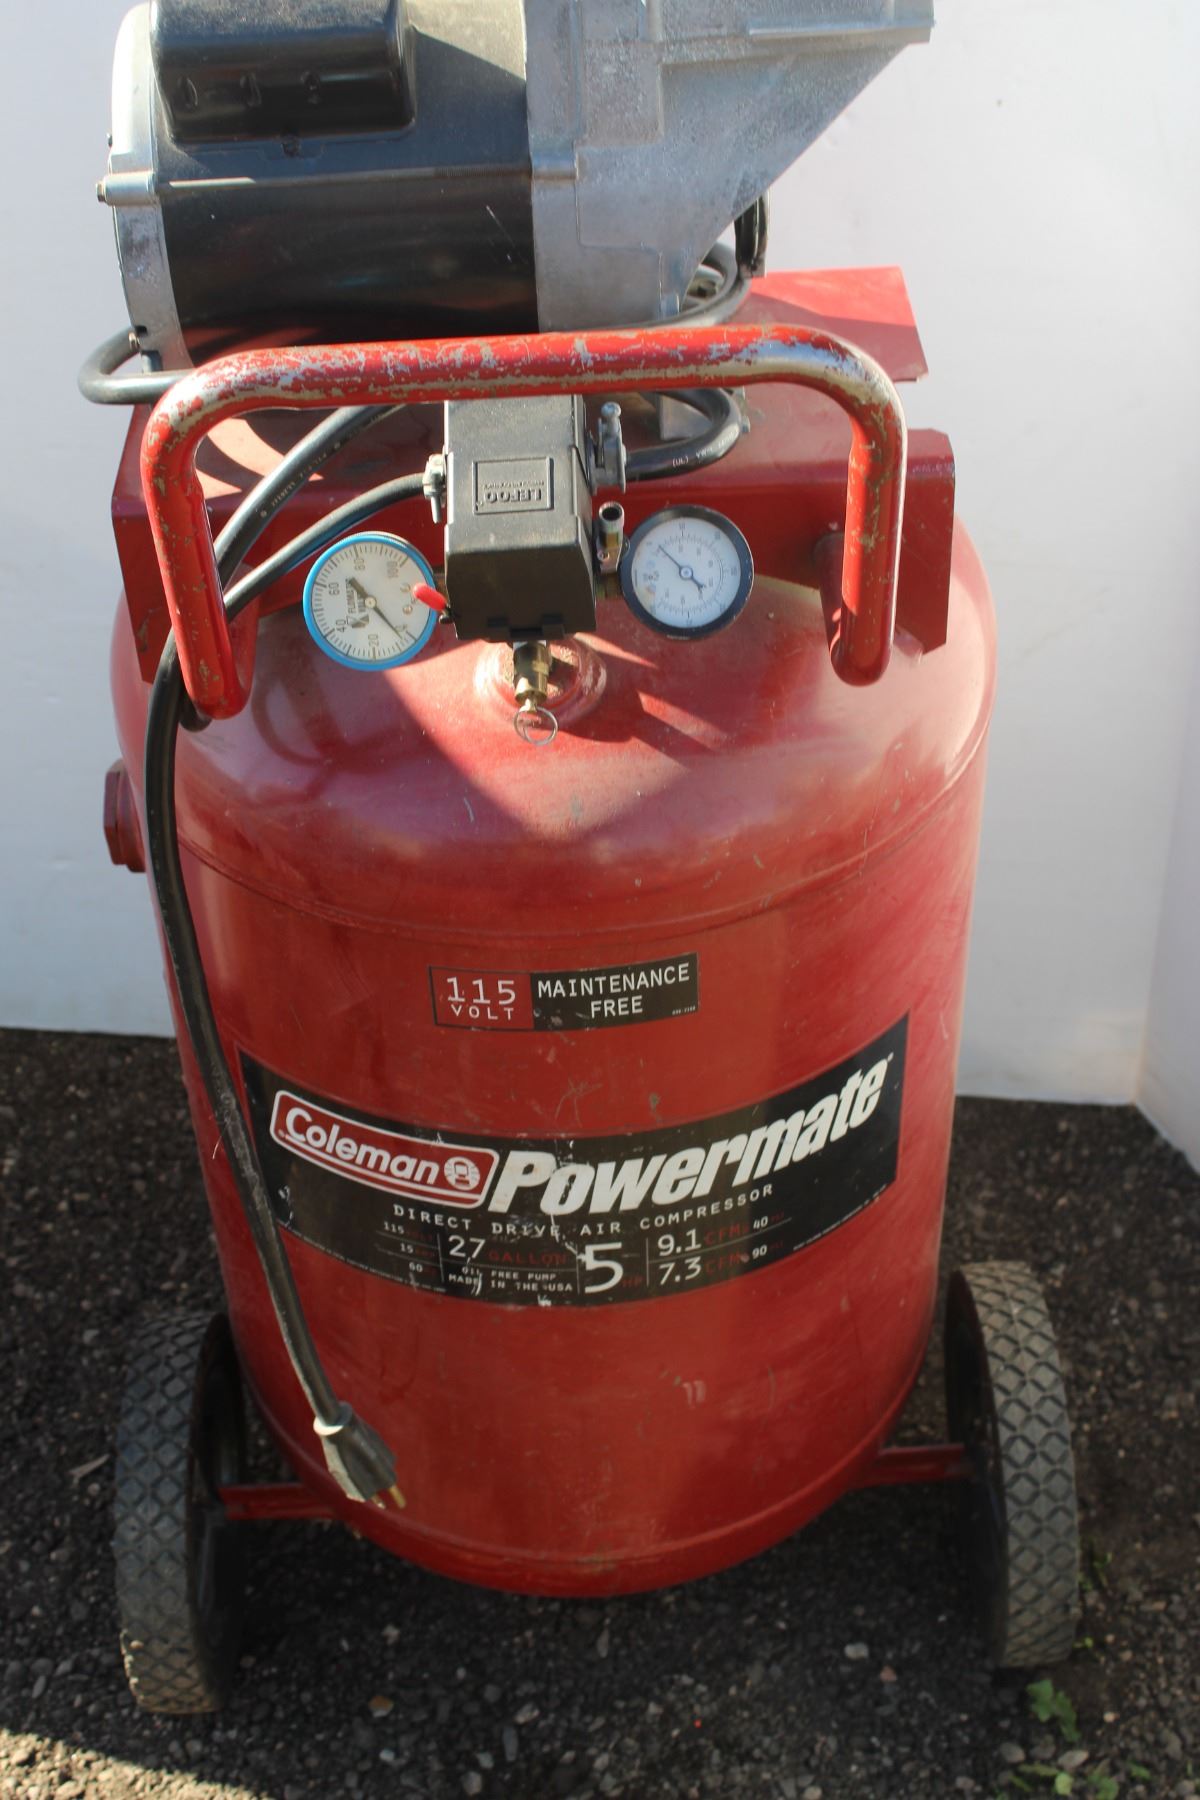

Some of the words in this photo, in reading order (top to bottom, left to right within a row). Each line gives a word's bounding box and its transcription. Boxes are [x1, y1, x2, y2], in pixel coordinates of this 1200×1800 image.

[354, 558, 366, 571] 80
[387, 560, 399, 579] 100
[328, 582, 340, 596] 60
[335, 619, 347, 633] 40
[368, 633, 380, 647] 20
[537, 962, 691, 999] MAINTENANCE
[447, 976, 516, 1006] 115
[450, 1004, 515, 1021] VOLT
[590, 995, 643, 1019] FREE
[285, 1106, 440, 1186] Coleman
[487, 1056, 890, 1217] Powermate
[393, 1203, 472, 1231] DIRECT
[491, 1221, 561, 1238] DRIVE
[579, 1221, 622, 1237] AIR
[639, 1183, 774, 1230] COMPRESSOR
[383, 1221, 405, 1235] 115
[657, 1228, 702, 1257] 9.1
[752, 1215, 769, 1230] 40
[400, 1242, 414, 1254] 15
[447, 1234, 486, 1259] 27
[488, 1250, 567, 1265] GALLON
[408, 1261, 423, 1273] 60
[584, 1242, 624, 1294] 5
[658, 1256, 702, 1286] 7.3
[752, 1244, 768, 1260] 90
[448, 1273, 479, 1285] MADE
[491, 1280, 506, 1289] IN
[515, 1282, 538, 1292] THE
[548, 1282, 573, 1292] USA
[491, 1270, 519, 1280] FREE
[527, 1272, 557, 1281] PUMP
